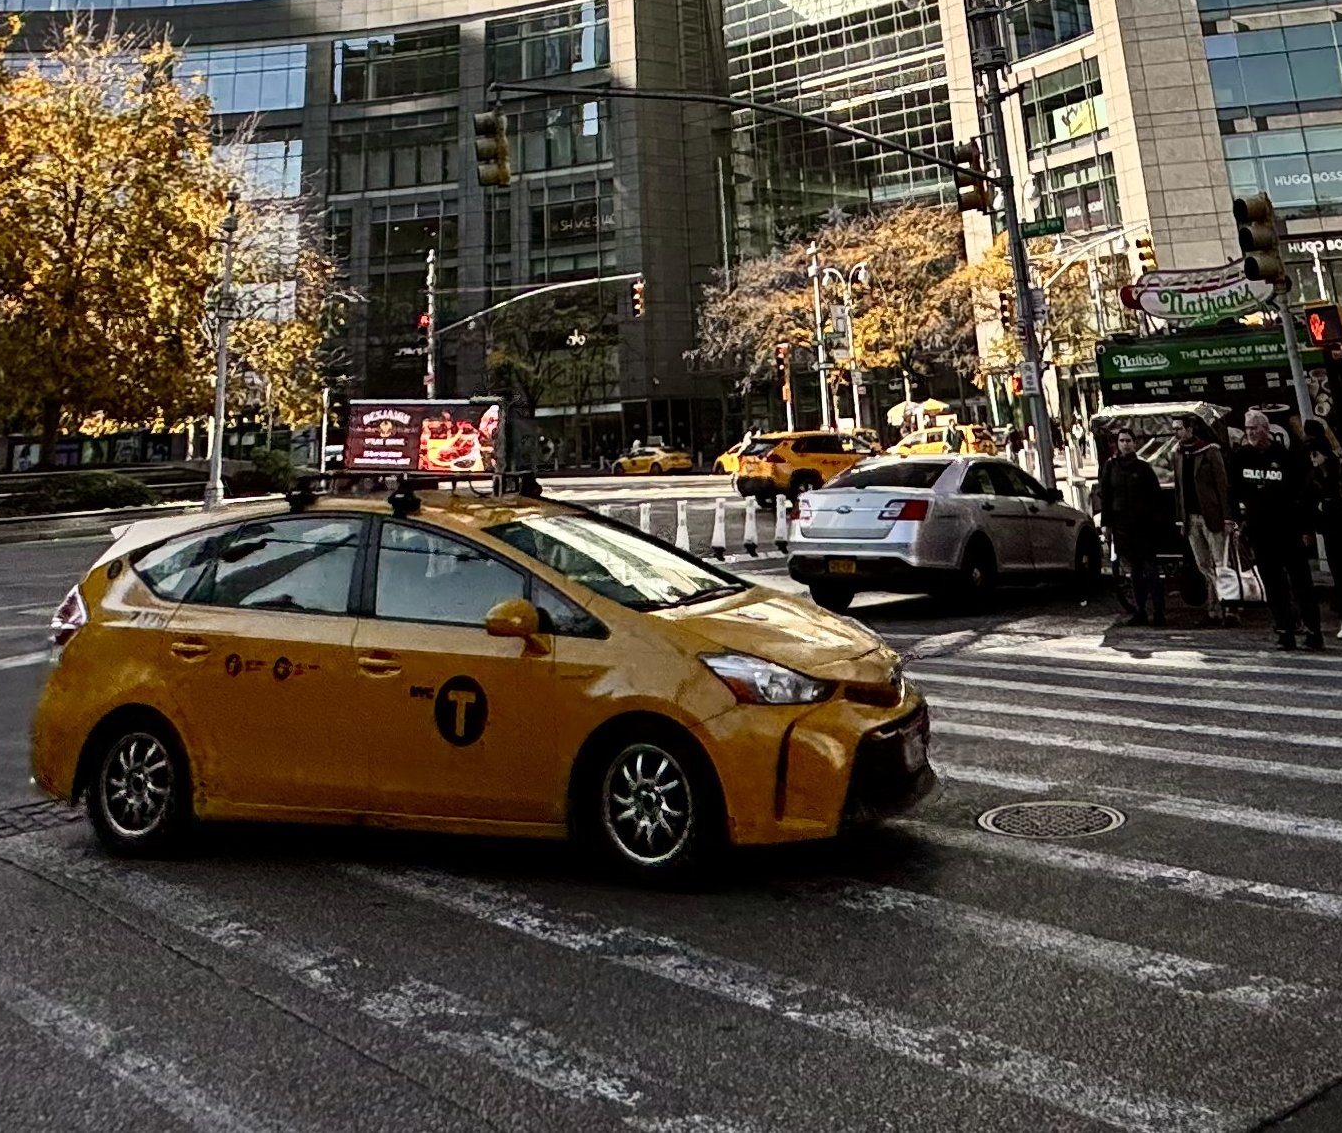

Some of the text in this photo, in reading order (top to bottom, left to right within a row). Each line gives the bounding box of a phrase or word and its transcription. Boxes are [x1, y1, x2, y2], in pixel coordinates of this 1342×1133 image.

[1273, 173, 1311, 187] HUGO
[1287, 240, 1325, 254] HUGO
[1158, 283, 1255, 316] Nathan's
[1179, 348, 1199, 360] THE
[1200, 345, 1237, 358] FLAVOR
[1238, 343, 1253, 355] OF
[1255, 340, 1279, 354] NEW
[1112, 351, 1170, 369] Nathan's
[409, 684, 435, 700] NYC
[447, 689, 477, 737] T
